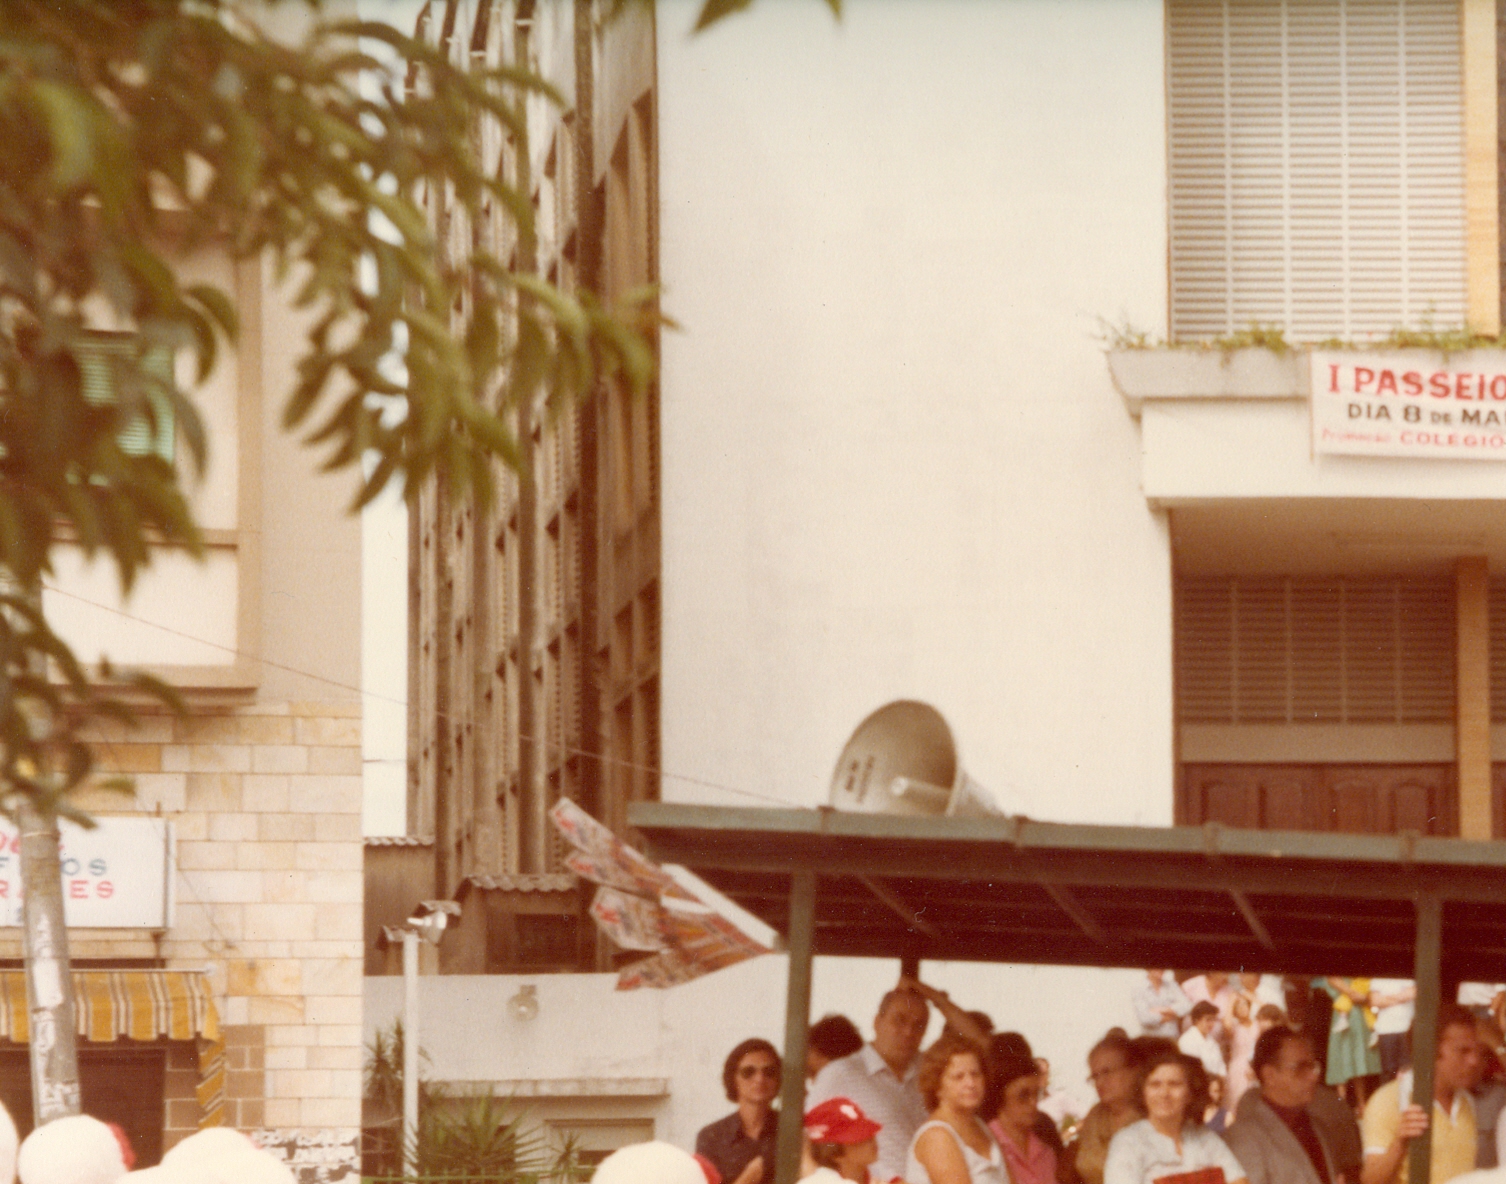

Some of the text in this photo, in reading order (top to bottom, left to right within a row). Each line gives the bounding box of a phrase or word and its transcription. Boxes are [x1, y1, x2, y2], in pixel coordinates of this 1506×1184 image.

[1329, 364, 1340, 393] I
[1348, 403, 1391, 420] DIA
[1403, 405, 1421, 423] 8
[1431, 411, 1451, 424] DE
